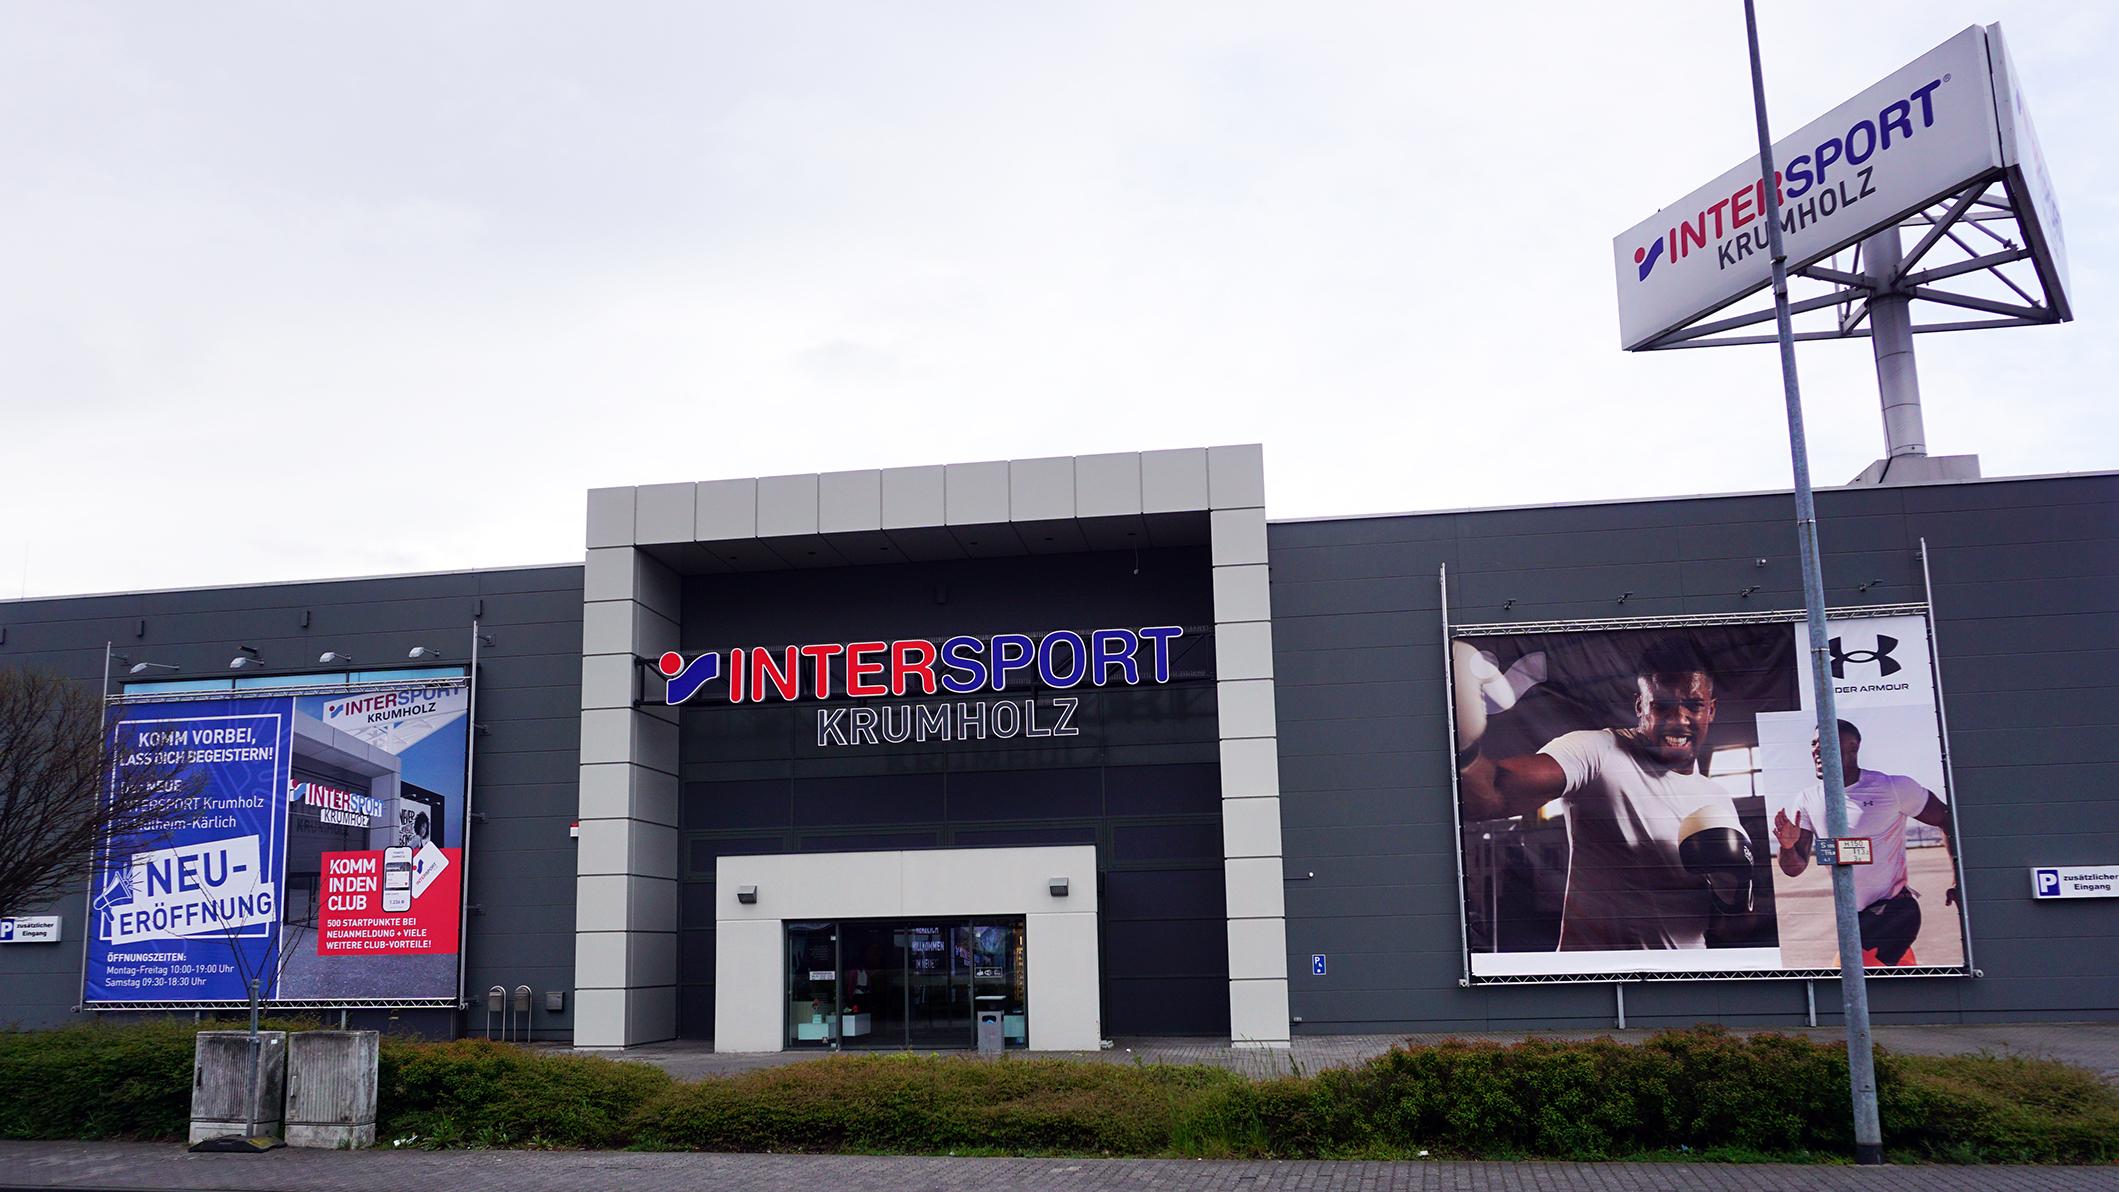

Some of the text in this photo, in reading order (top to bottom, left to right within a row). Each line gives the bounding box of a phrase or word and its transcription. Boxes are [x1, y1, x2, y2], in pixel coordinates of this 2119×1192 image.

[1669, 78, 1942, 265] INTERSPORT
[1718, 165, 1877, 270] KRUMHOLZ
[729, 625, 1184, 703] INTERSPORT
[1834, 683, 1910, 694] DER ARMOUR
[367, 702, 436, 723] KRUMHOLZ
[816, 697, 1080, 747] KRUMHOLZ
[138, 727, 257, 748] KOMM VORBEI,
[154, 750, 185, 765] DICH
[187, 746, 273, 763] BEGEISTERN!
[203, 795, 264, 810] Krumholz
[147, 850, 247, 897] NEU-
[329, 858, 376, 875] KOMM
[328, 877, 344, 893] IN
[346, 876, 377, 892] DEN
[2039, 873, 2119, 893] P zusätzlicher
[2074, 883, 2111, 891] Eingang
[327, 895, 367, 911] CLUB
[120, 892, 272, 936] ERÖFFNUNG
[327, 917, 417, 928] 500 STARTPUNKTE BEI
[1, 921, 13, 938] P
[22, 930, 47, 938] Eingang
[326, 929, 395, 939] NEUANMELDUNG
[403, 928, 427, 937] VIELE
[326, 939, 432, 949] WEITERE CLUB-VORTEILE!
[107, 952, 187, 963] ÖFFNUNGSZEITEN:
[106, 963, 234, 976] Montag-Freitag 10:00-19:00 Uhr
[105, 975, 207, 989] Samstag 09:30-18:30 Uhr
